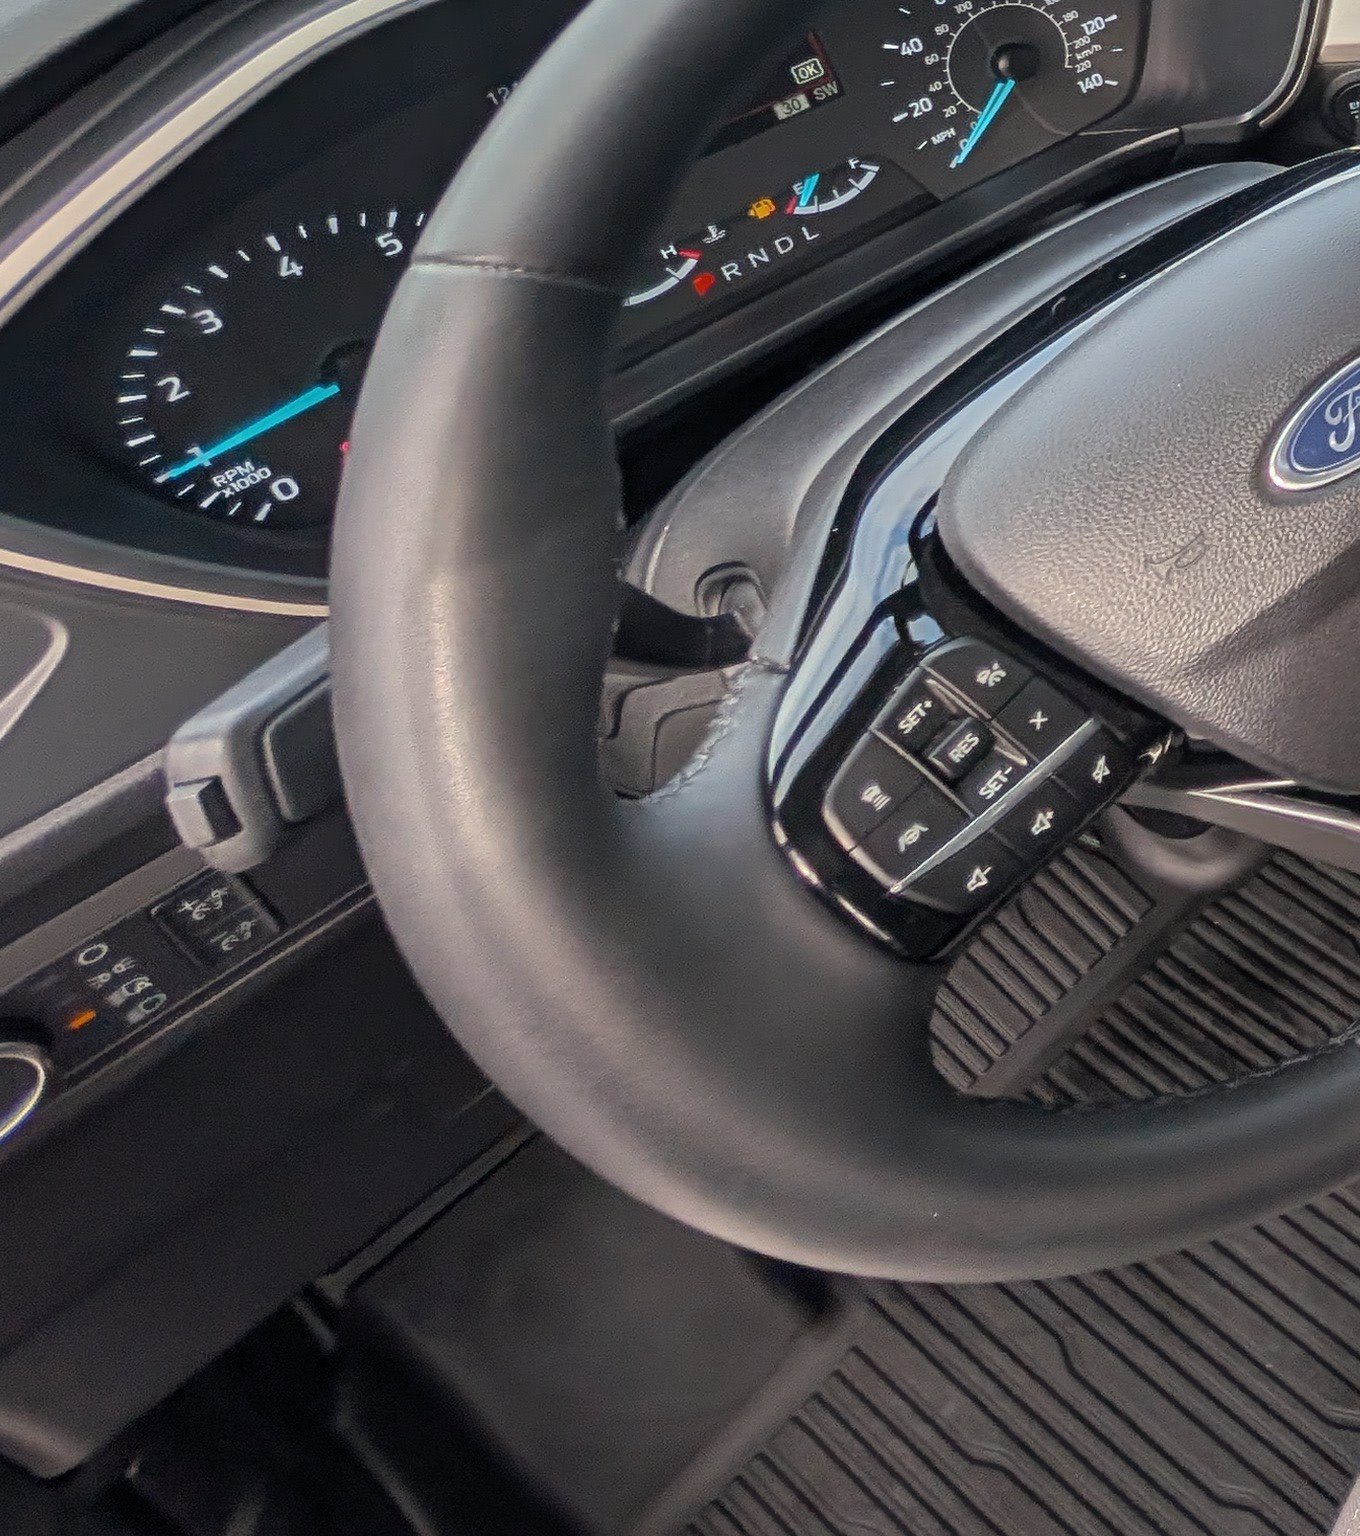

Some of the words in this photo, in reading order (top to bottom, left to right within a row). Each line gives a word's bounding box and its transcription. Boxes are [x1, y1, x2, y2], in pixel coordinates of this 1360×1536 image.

[953, 0, 973, 15] 100
[934, 23, 950, 36] 80
[1081, 16, 1106, 36] 120
[900, 37, 923, 56] 40
[1075, 44, 1103, 61] km/h
[924, 53, 940, 66] 60
[798, 63, 820, 80] OK
[928, 81, 943, 93] 40
[1077, 73, 1104, 94] 140
[782, 98, 802, 116] 30
[813, 80, 839, 100] SW
[908, 96, 934, 119] 20
[942, 105, 958, 119] 20
[930, 127, 957, 146] MPH
[848, 157, 860, 169] F
[375, 231, 404, 257] 5
[660, 244, 678, 260] H
[720, 262, 743, 282] R
[747, 247, 771, 269] N
[774, 235, 795, 255] D
[801, 225, 820, 242] L
[279, 255, 304, 278] 4
[190, 308, 224, 335] 3
[156, 375, 192, 403] 2
[212, 460, 256, 488] RPM
[269, 476, 300, 502] 0
[947, 731, 980, 764] RES
